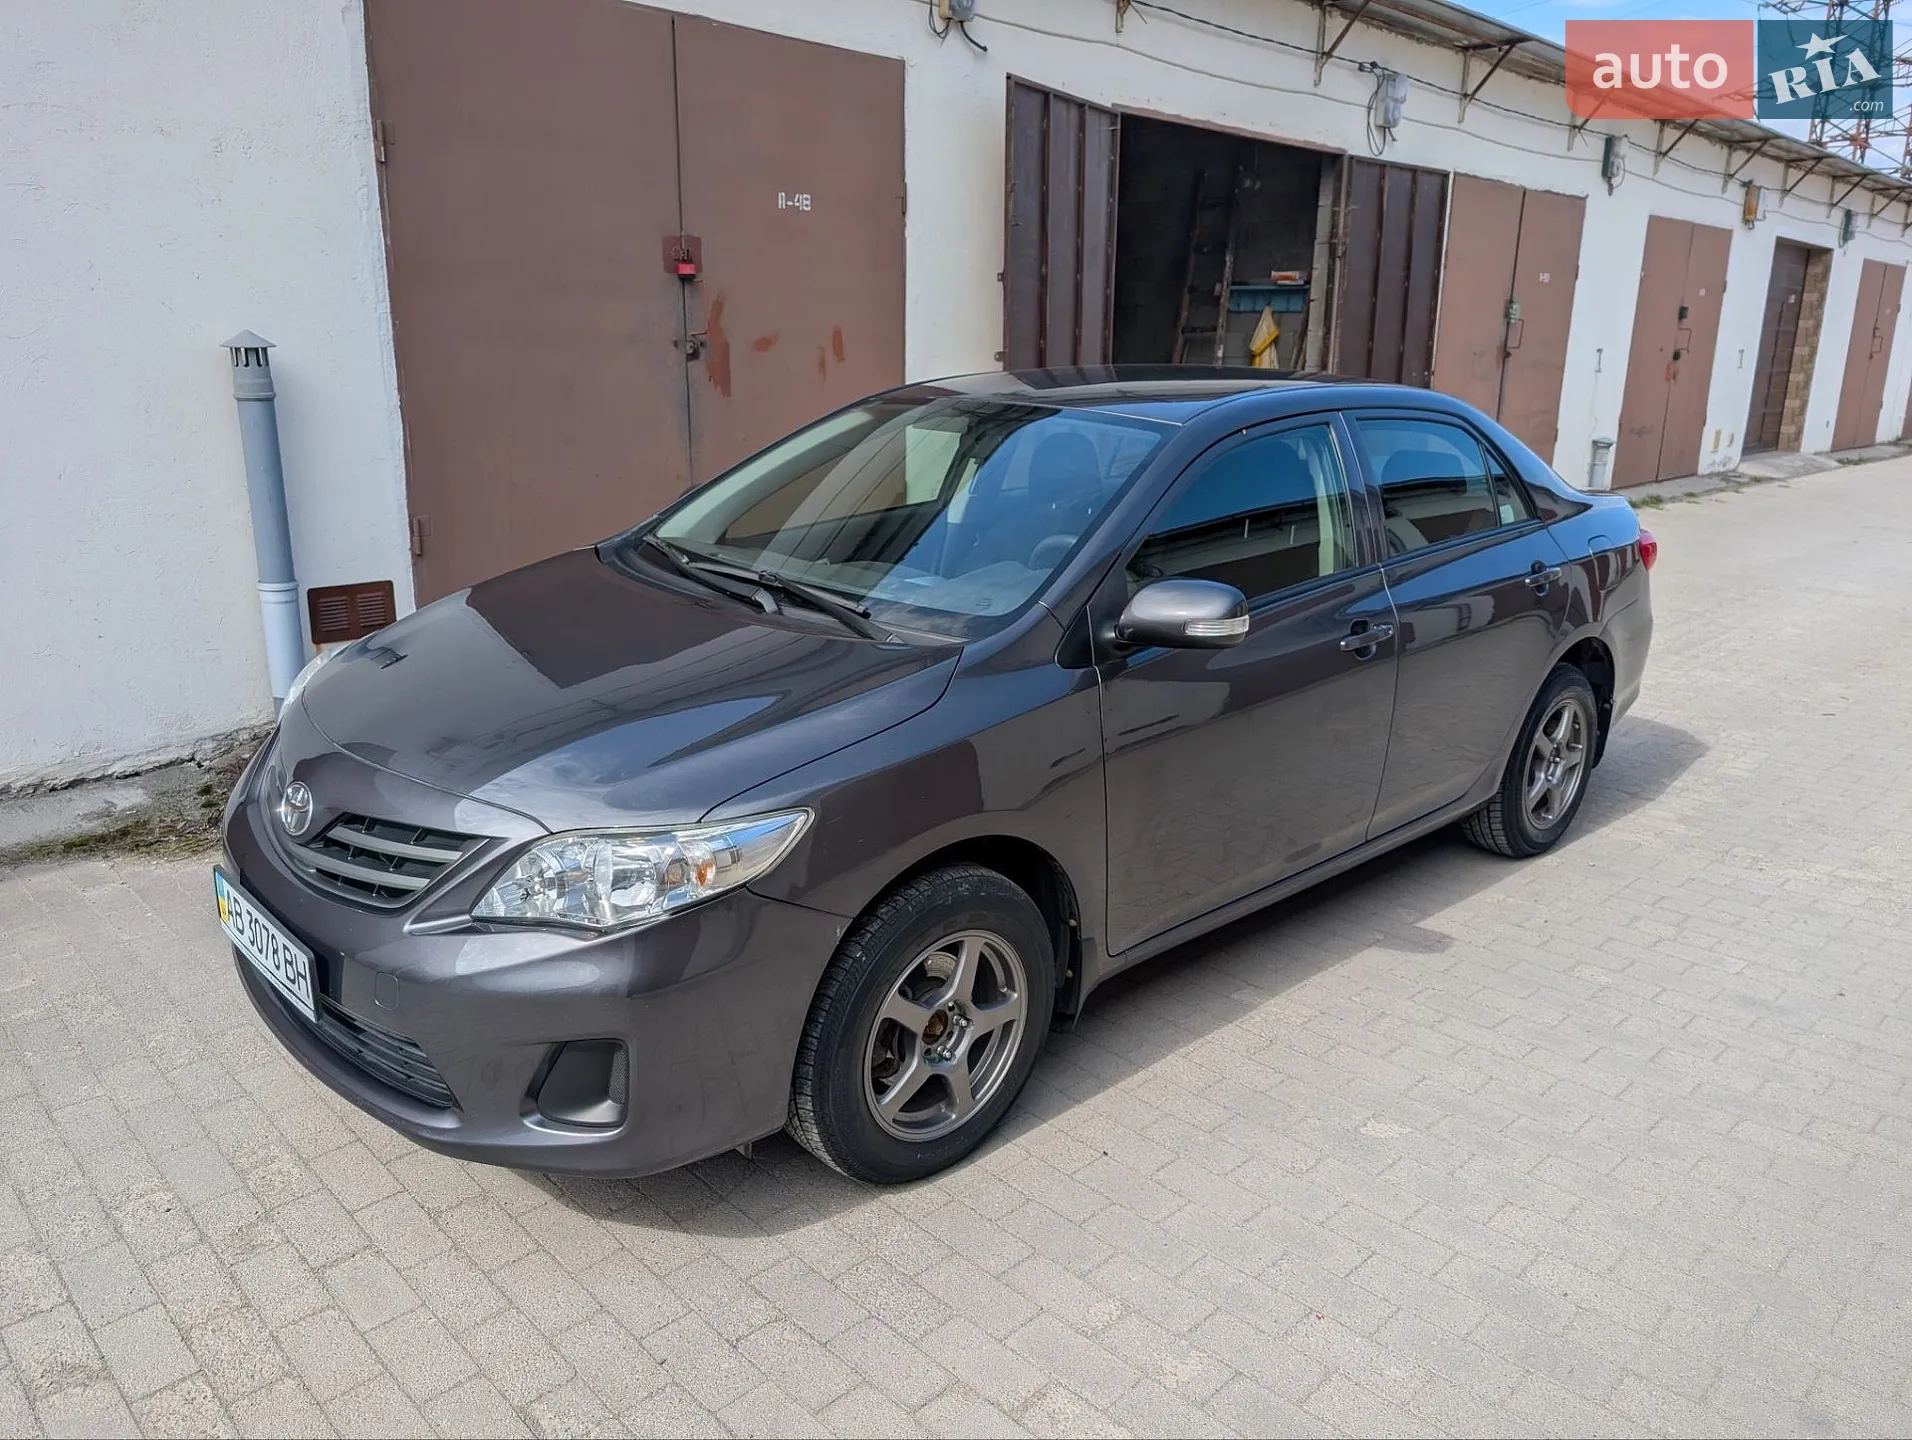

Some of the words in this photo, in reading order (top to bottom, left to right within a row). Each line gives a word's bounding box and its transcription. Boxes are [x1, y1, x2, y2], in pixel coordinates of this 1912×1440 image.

[226, 889, 245, 936] AB
[246, 908, 281, 972] 3078
[282, 942, 311, 1001] BH
